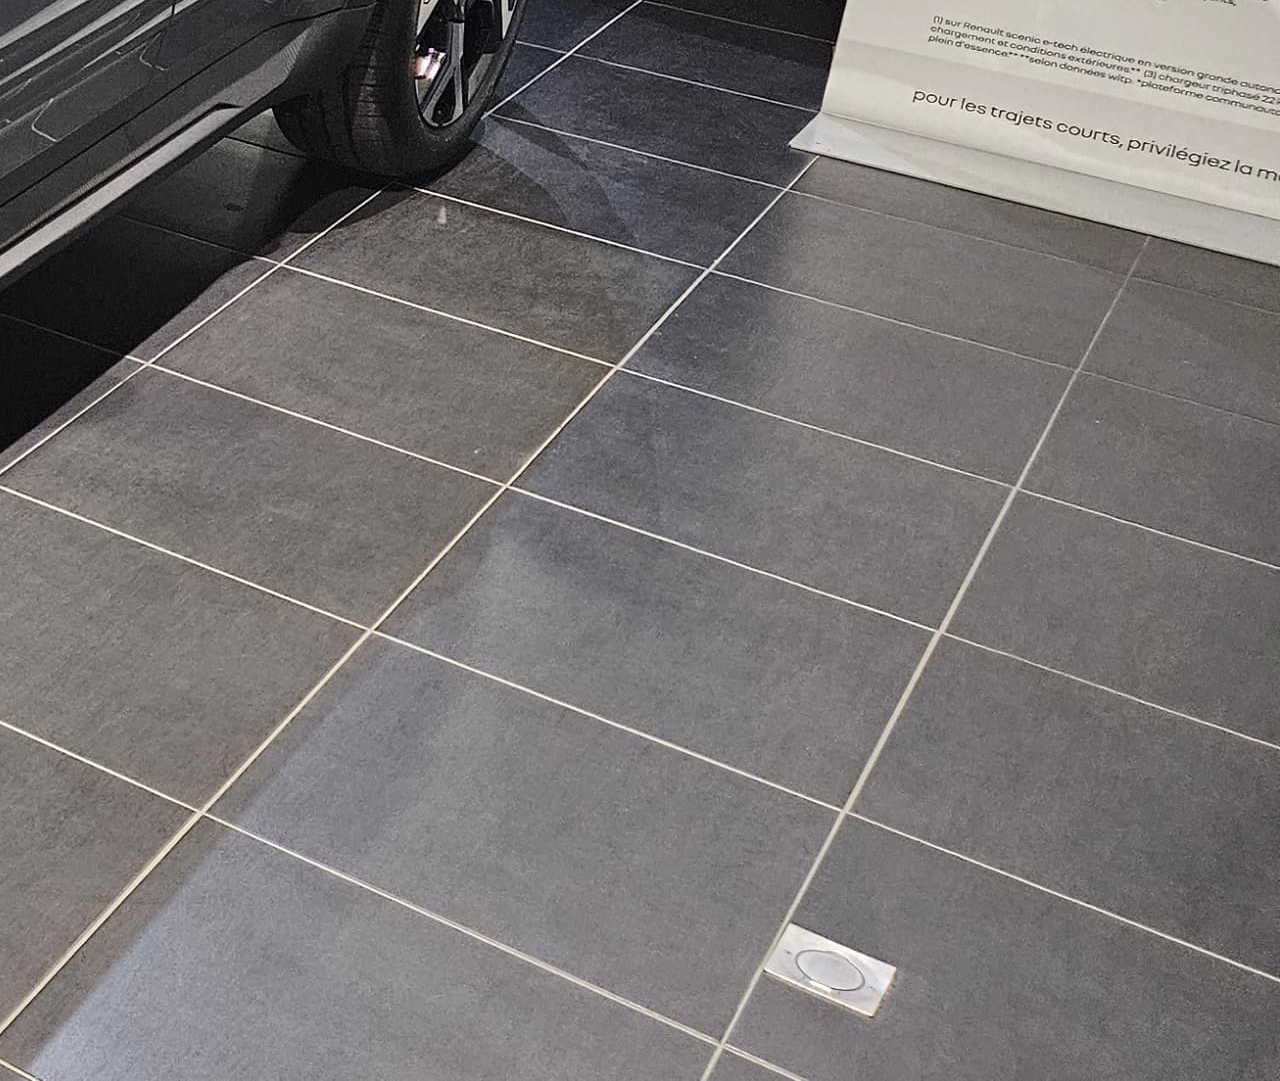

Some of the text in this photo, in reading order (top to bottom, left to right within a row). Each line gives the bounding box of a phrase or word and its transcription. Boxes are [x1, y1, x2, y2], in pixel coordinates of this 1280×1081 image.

[912, 90, 958, 107] pour
[960, 97, 986, 114] les
[990, 106, 1052, 129] trajets
[1056, 122, 1123, 148] courts,
[1126, 139, 1231, 171] privilégiez
[1234, 159, 1253, 175] la
